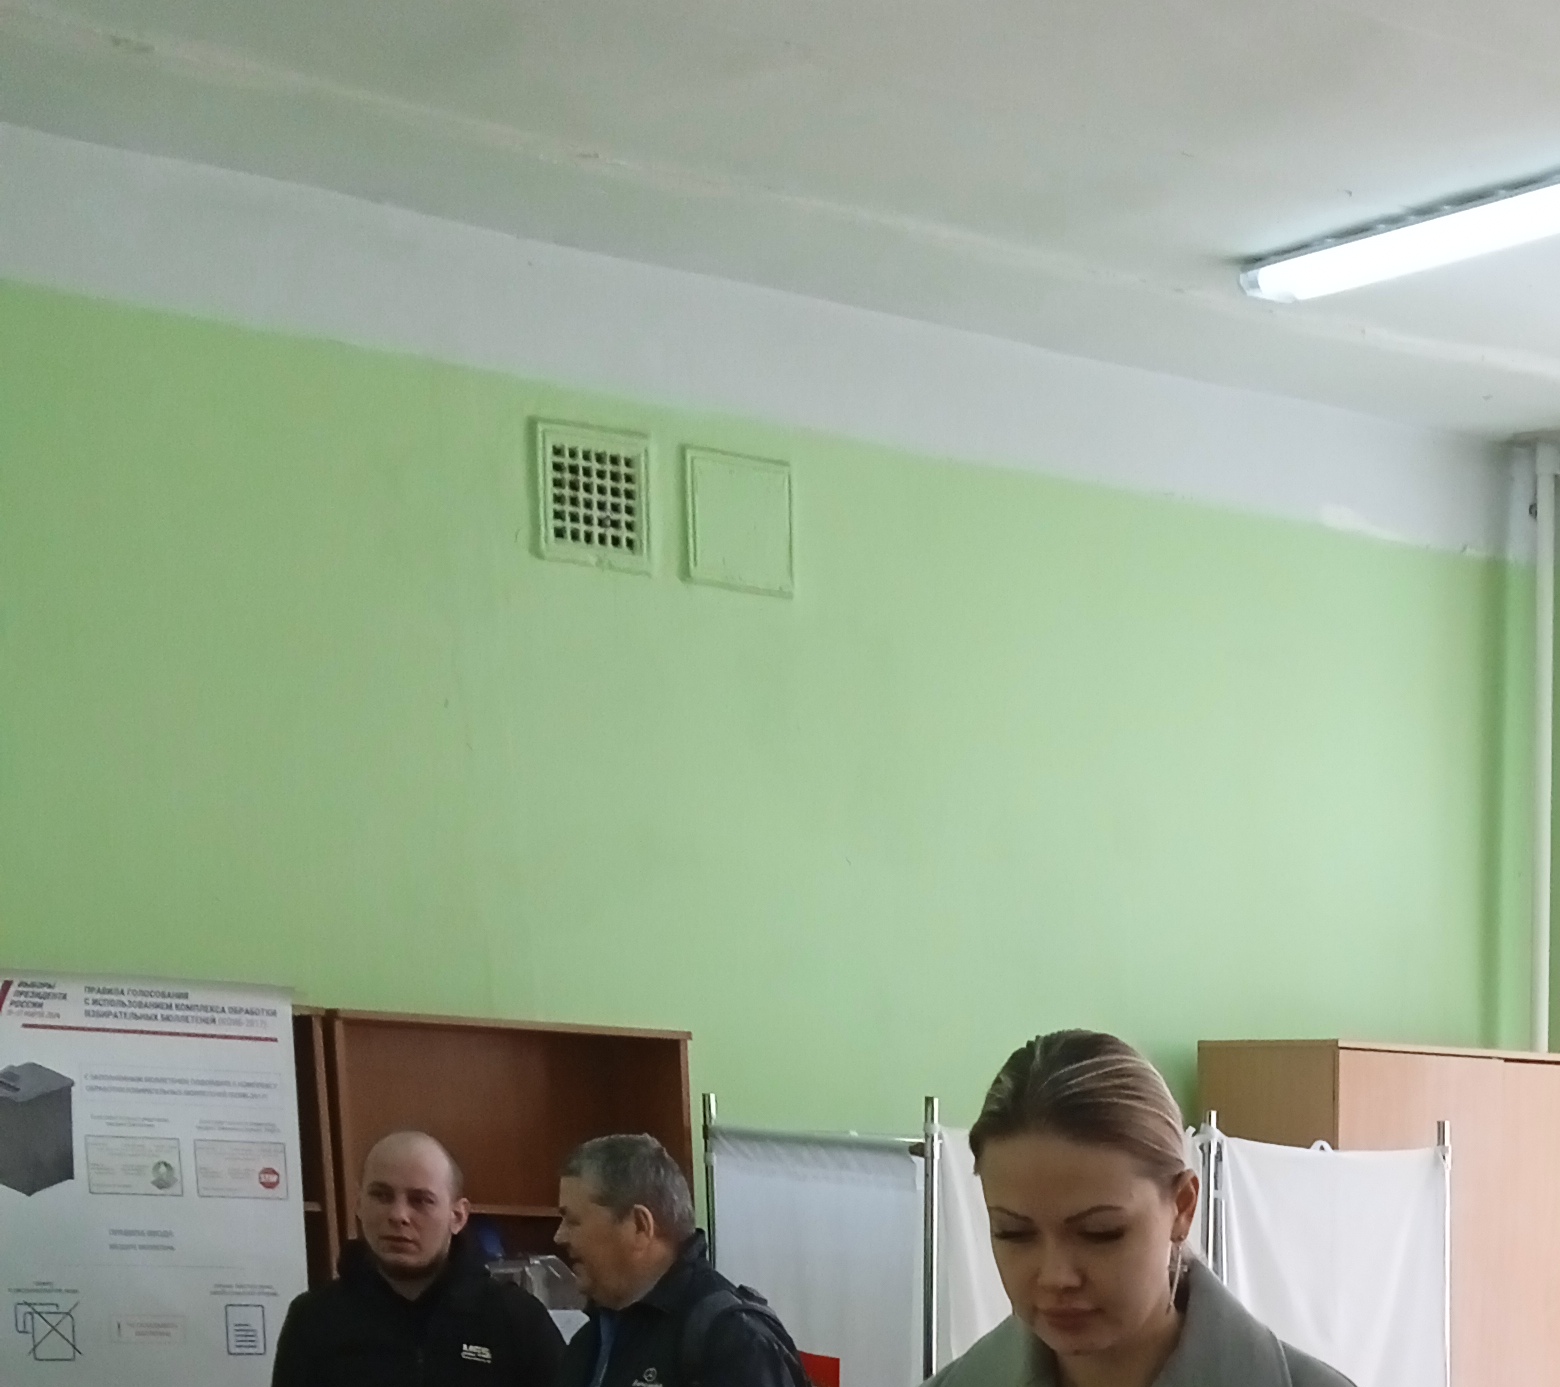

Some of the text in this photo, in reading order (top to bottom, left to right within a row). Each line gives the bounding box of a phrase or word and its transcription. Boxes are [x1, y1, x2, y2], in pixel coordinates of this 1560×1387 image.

[84, 986, 189, 999] ПРАВИЛА ГОЛОСОВАНИЯ
[84, 998, 90, 1006] С
[92, 999, 173, 1010] ИСПОЛЬЗОВАНИЕМ
